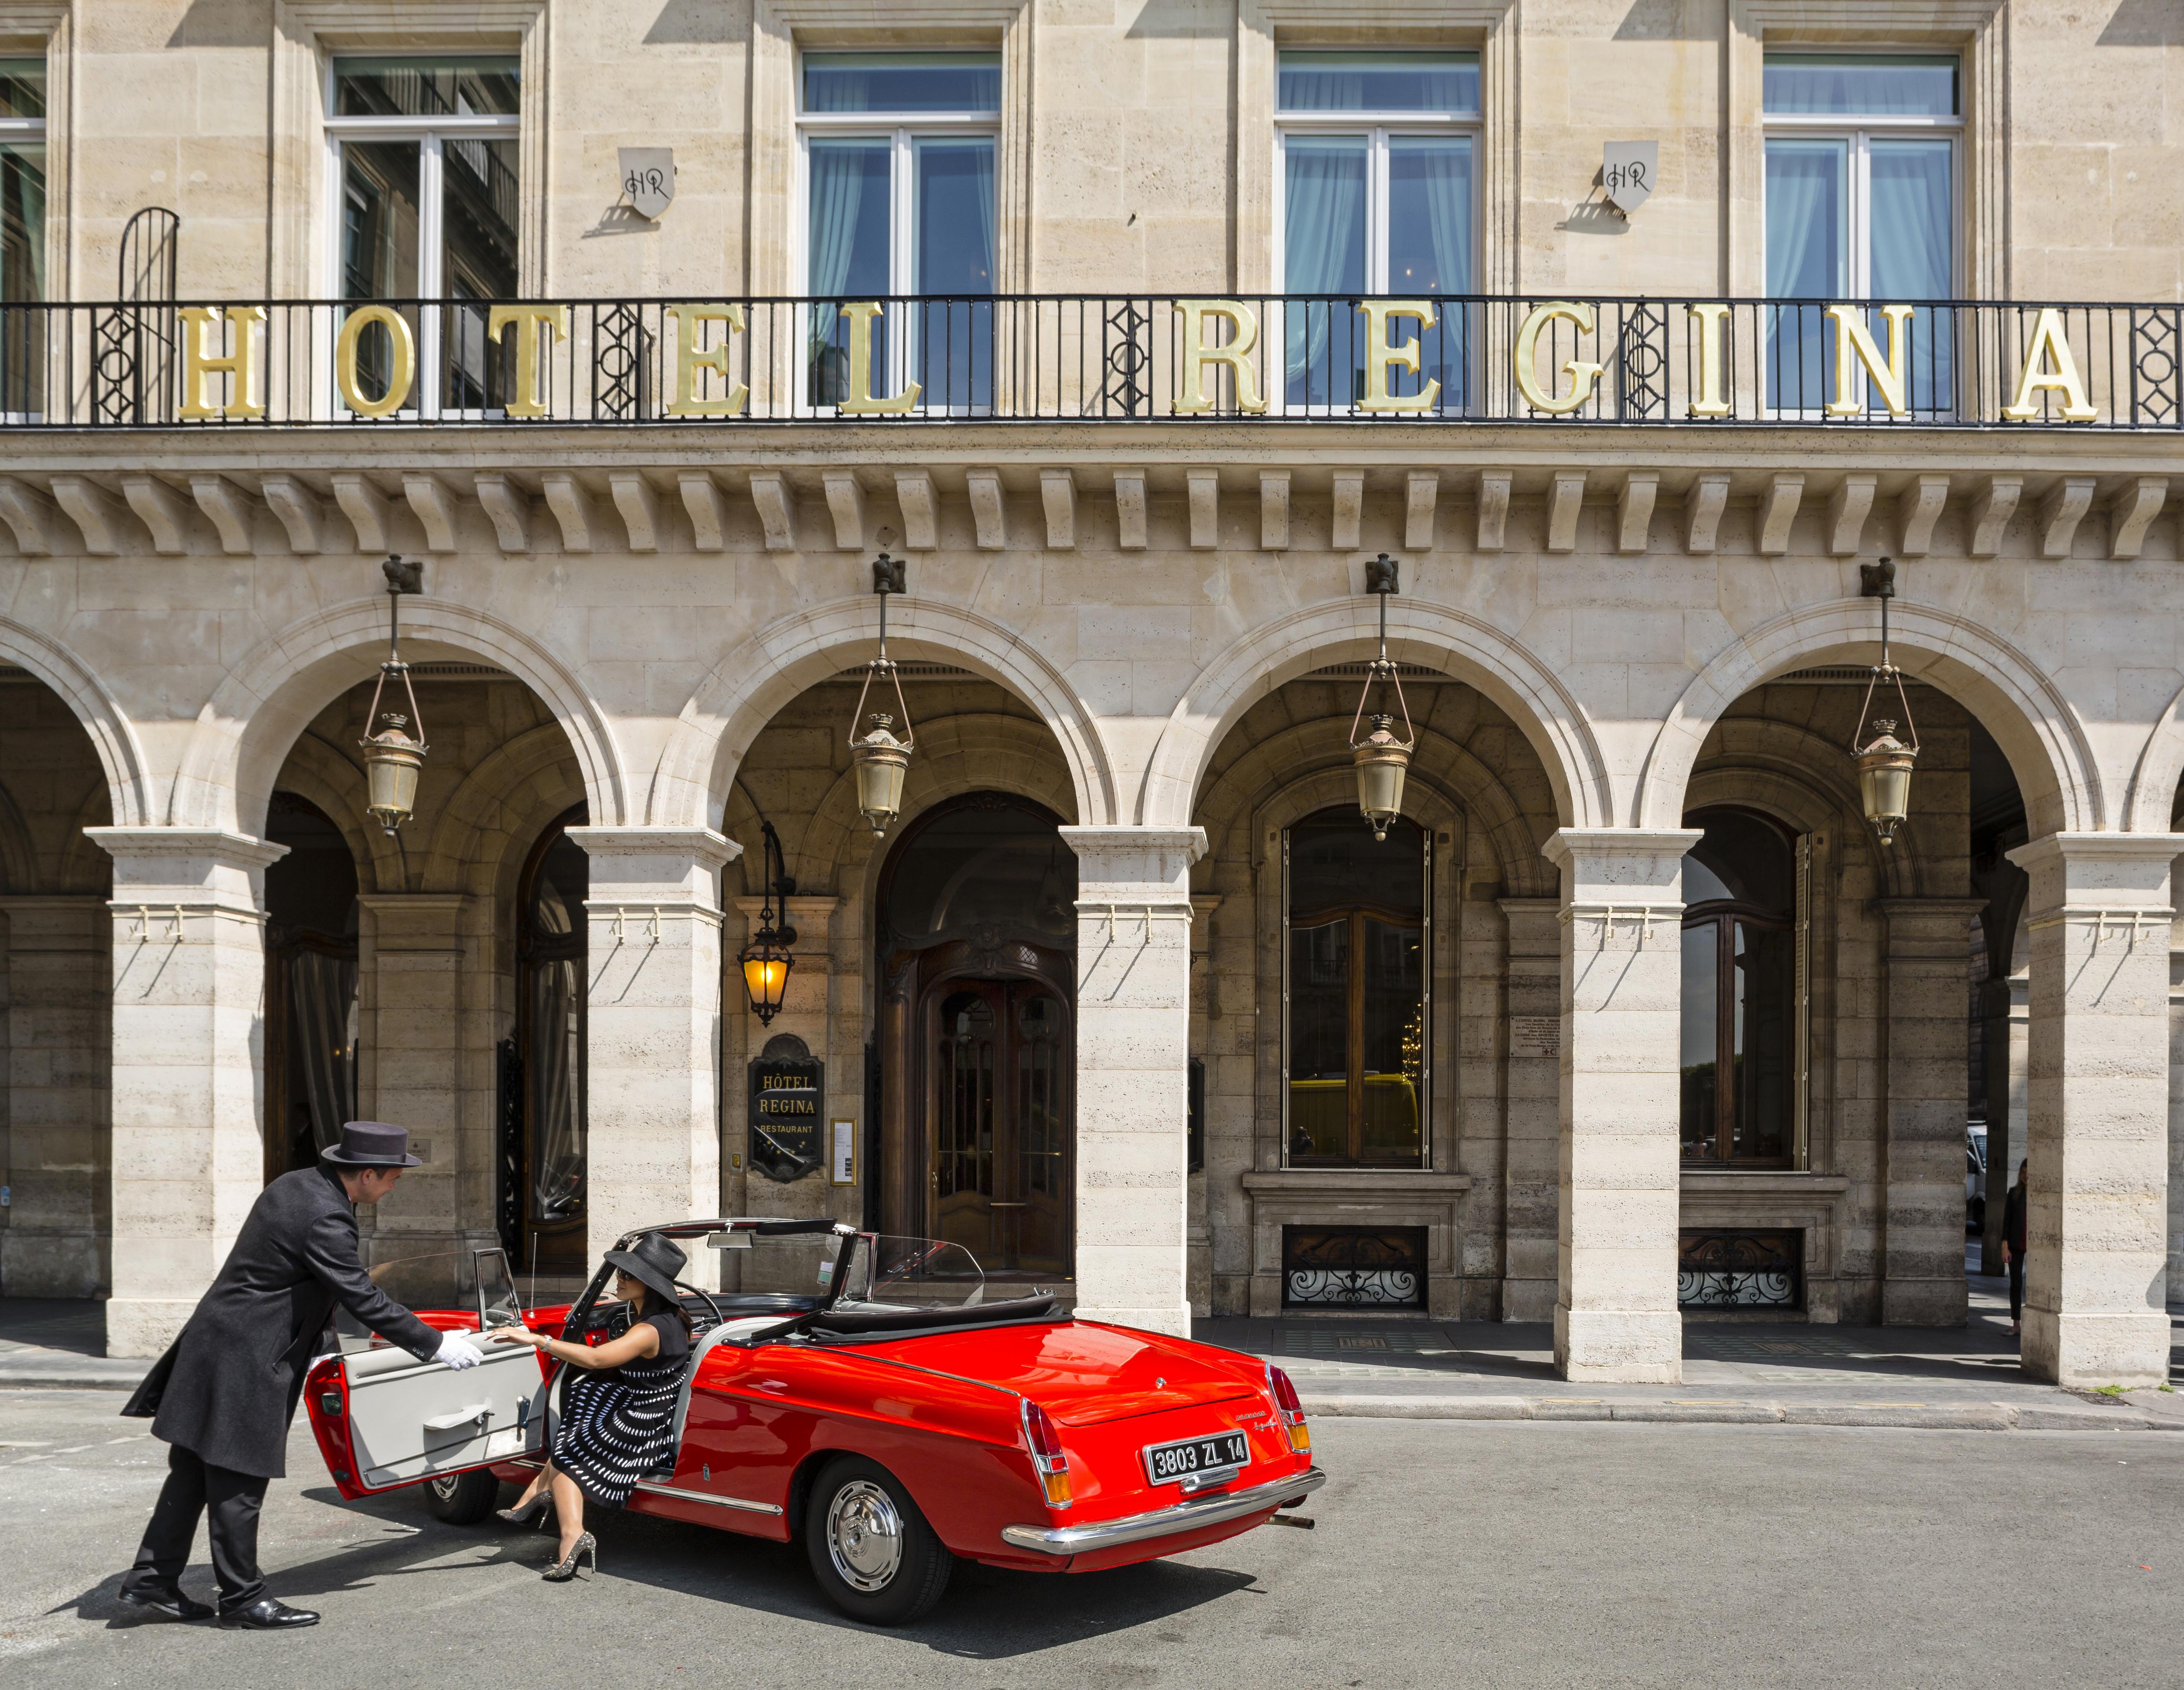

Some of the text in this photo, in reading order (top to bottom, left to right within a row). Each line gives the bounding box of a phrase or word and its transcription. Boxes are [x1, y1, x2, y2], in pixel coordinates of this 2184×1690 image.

[625, 168, 670, 202] HR
[1606, 161, 1651, 197] HR
[177, 299, 2100, 422] HOTEL REGINA
[763, 1073, 812, 1089] HÔTEL
[760, 1099, 815, 1113] REGINA
[1155, 1437, 1245, 1475] 3803 ZL 14
